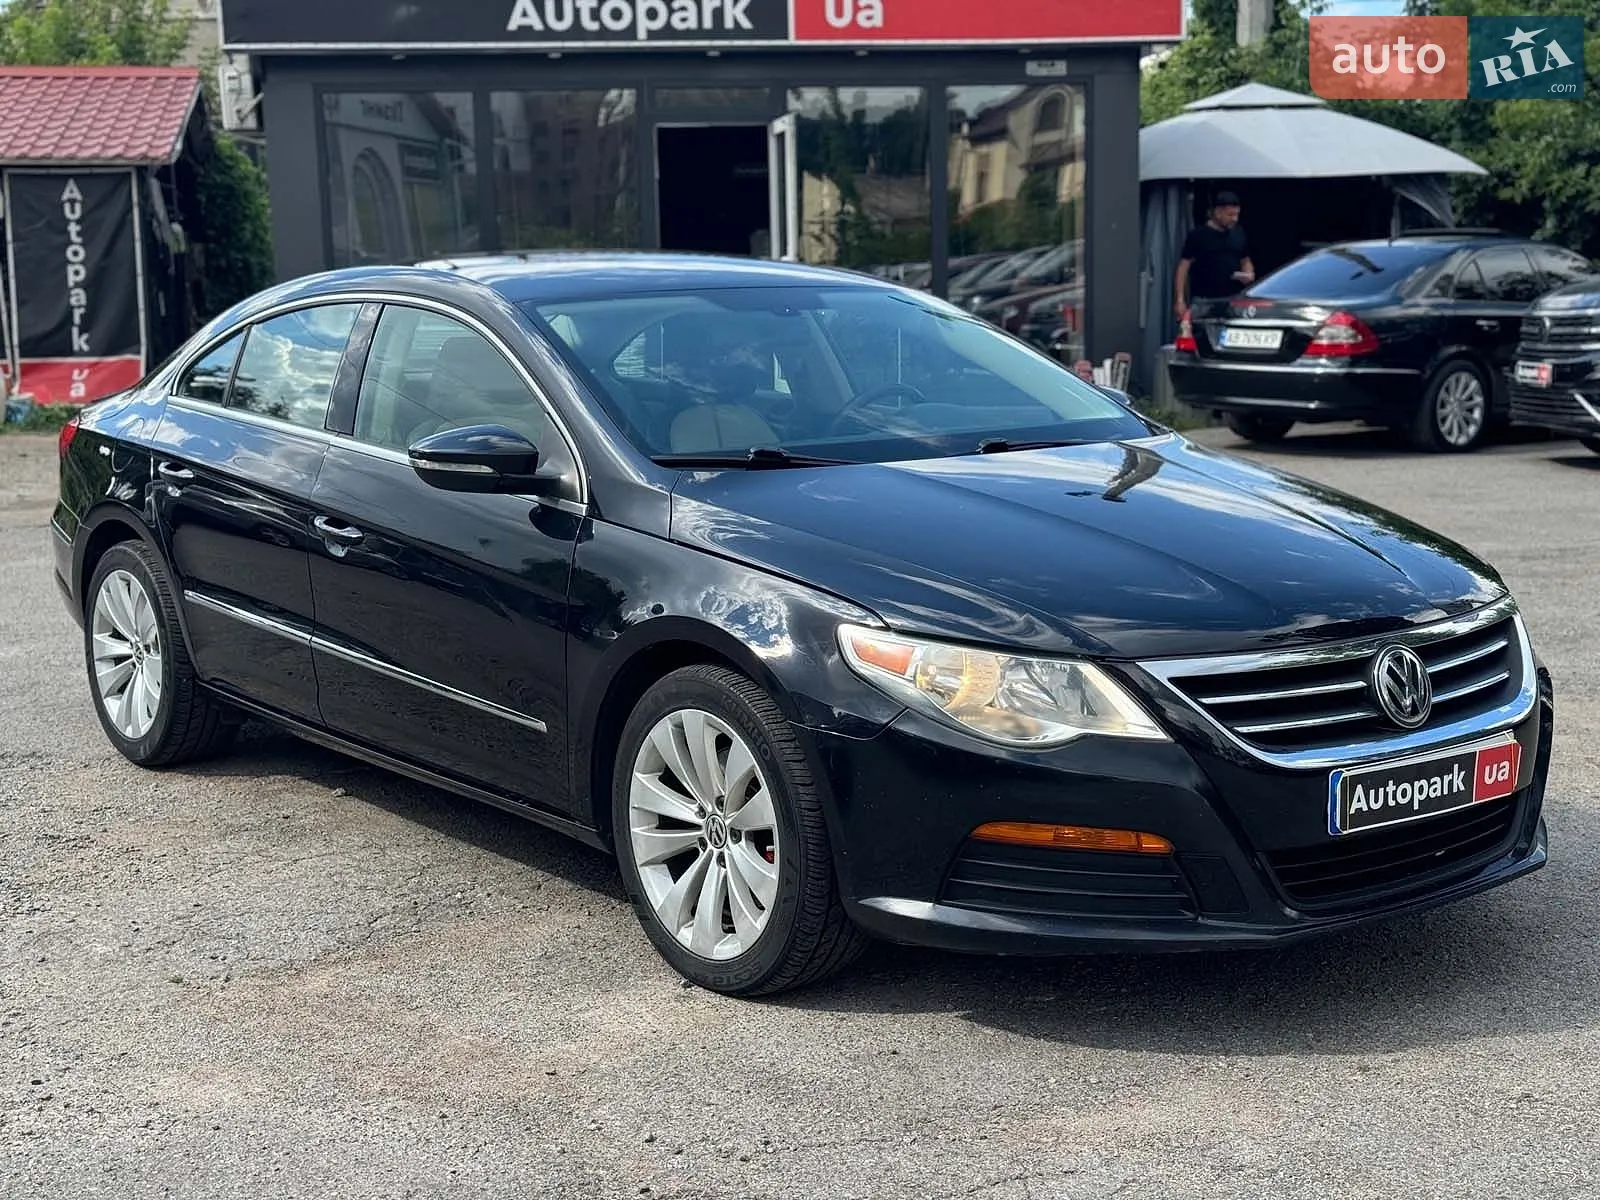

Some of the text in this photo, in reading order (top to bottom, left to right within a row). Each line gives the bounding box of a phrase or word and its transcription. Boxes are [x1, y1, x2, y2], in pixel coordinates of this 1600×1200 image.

[506, 0, 754, 40] Autopark
[61, 178, 90, 352] Autopark
[1349, 760, 1509, 815] Autopark ua
